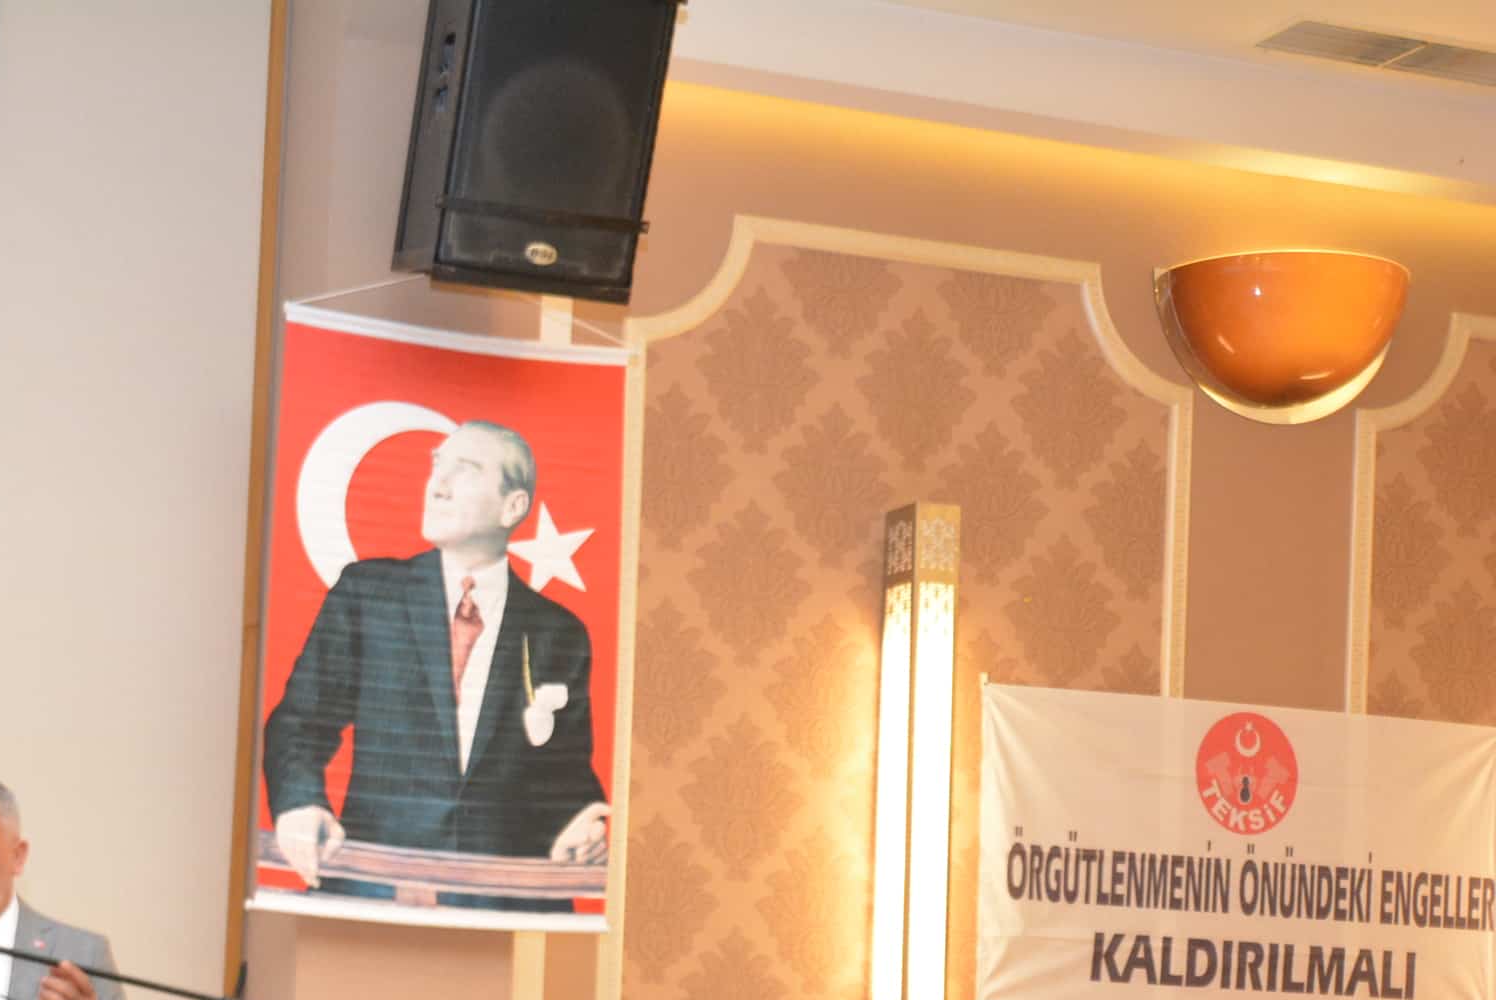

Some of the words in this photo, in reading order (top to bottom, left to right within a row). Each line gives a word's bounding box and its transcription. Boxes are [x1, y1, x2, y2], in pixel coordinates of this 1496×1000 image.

[1006, 826, 1231, 914] ÖRGÜTLENMENİN
[1239, 843, 1374, 924] ÖNÜNDEKİ
[1089, 931, 1418, 1000] KALDIRILMALI
